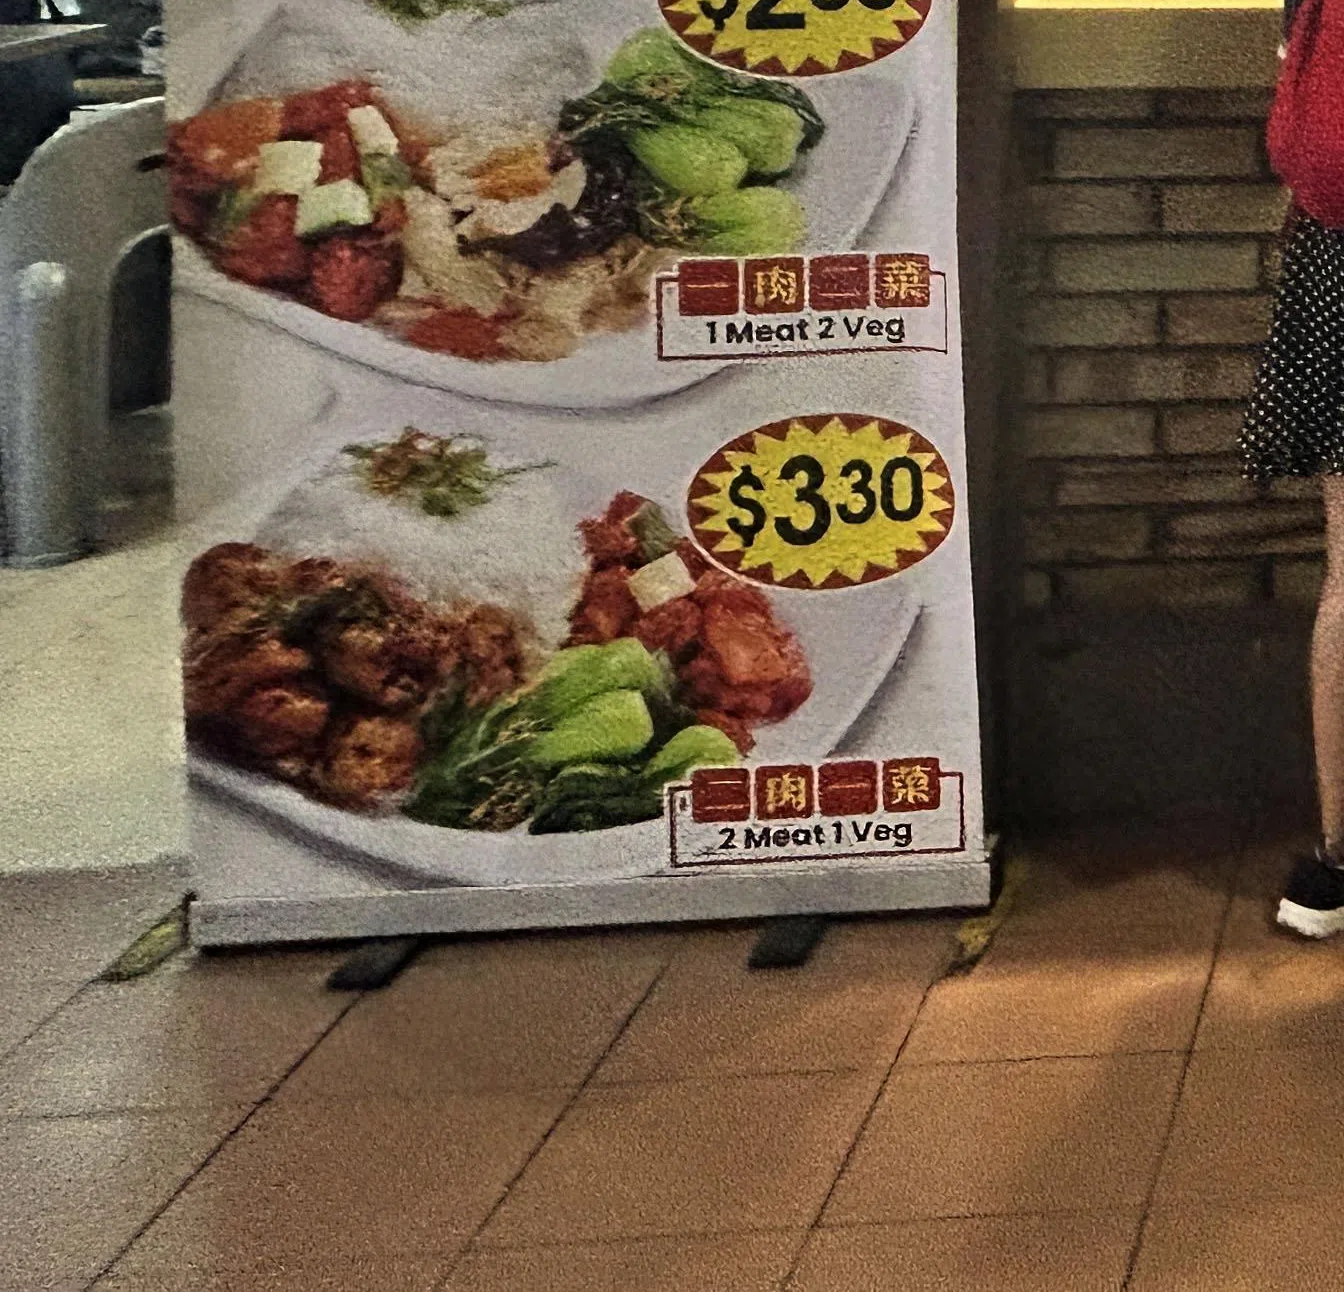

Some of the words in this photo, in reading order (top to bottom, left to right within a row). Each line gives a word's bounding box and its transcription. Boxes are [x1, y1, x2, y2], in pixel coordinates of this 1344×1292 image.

[705, 321, 718, 344] 1
[725, 317, 809, 344] Meat
[818, 315, 836, 340] 2
[839, 314, 906, 344] Veg
[718, 827, 738, 850] 2
[743, 823, 826, 849] Meat
[831, 822, 842, 844] 1
[852, 819, 913, 848] Veg
